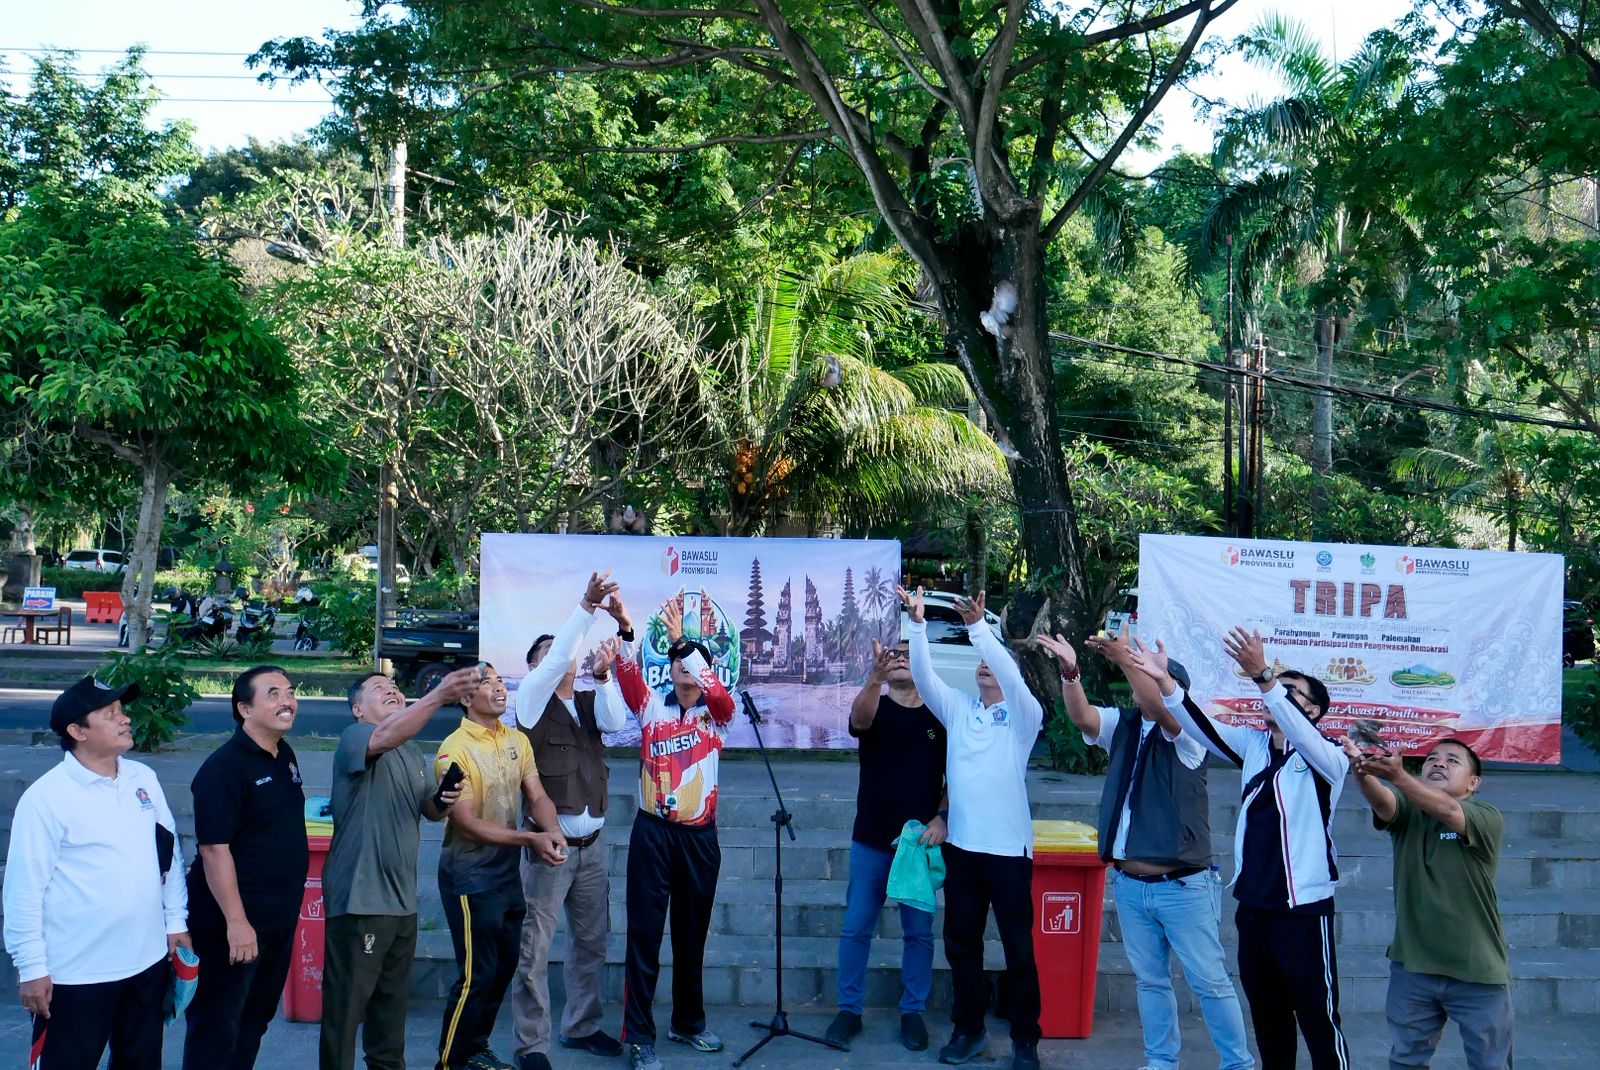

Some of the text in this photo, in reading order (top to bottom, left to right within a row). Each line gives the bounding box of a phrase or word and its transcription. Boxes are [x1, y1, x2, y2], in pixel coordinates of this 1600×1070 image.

[681, 551, 718, 561] BAWASLU
[1240, 549, 1294, 559] BAWASLU
[1240, 560, 1276, 568] PROVINSI
[1415, 558, 1469, 570] BAWASLU
[706, 567, 718, 575] BALI
[1289, 579, 1408, 619] TRIPA
[1274, 628, 1421, 643] Parahyangan Pawongan Palemahan
[1269, 637, 1308, 646] Penguatan
[1309, 638, 1348, 648] Partisipasi
[1349, 641, 1363, 649] dan
[1363, 642, 1409, 651] Pengawasan
[1410, 644, 1449, 653] Demokrasi
[1339, 705, 1376, 716] Awasi
[1376, 706, 1419, 719] Pemilu
[1231, 715, 1265, 725] Bersam
[1399, 725, 1432, 735] Pemilu
